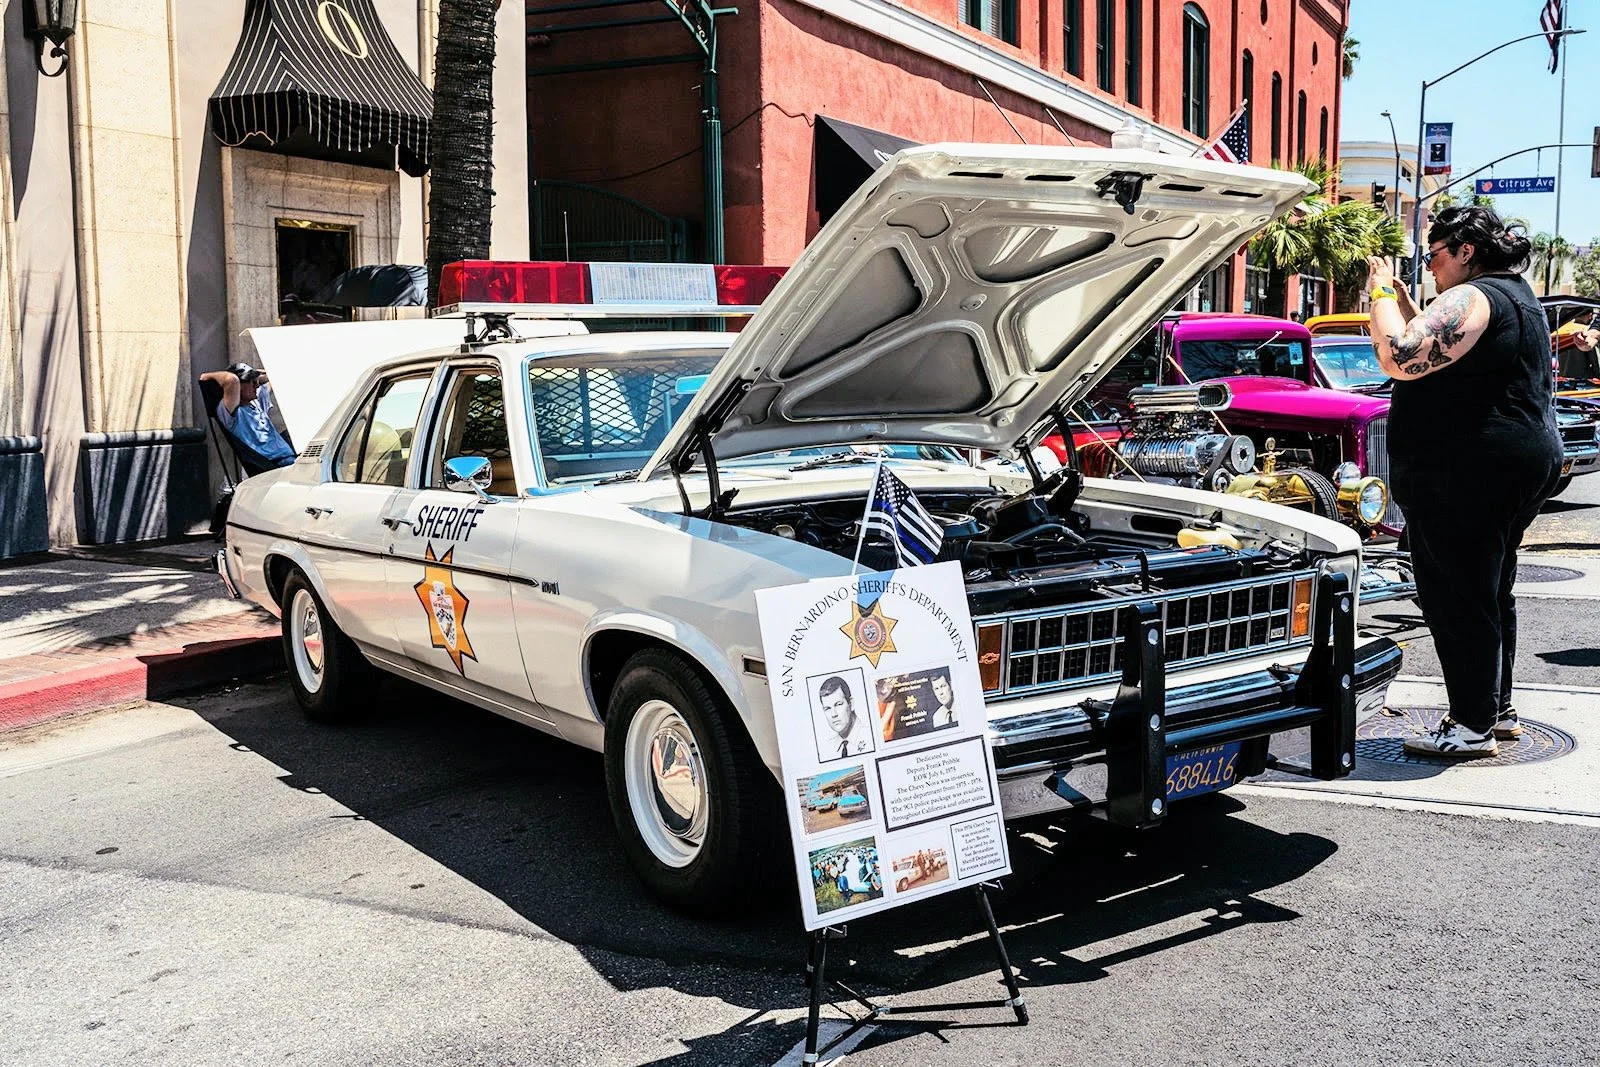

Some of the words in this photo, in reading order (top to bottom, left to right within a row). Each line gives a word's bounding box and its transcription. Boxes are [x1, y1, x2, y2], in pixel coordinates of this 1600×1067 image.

[1498, 179, 1531, 188] Citrus
[1536, 178, 1554, 187] Ave
[412, 504, 484, 542] SHERIFF
[851, 580, 907, 596] SHERIFF'S
[785, 586, 849, 661] BERNARDINO
[908, 587, 969, 662] DEPARTMENT
[782, 665, 794, 697] SAN
[917, 753, 942, 764] Dedicated
[927, 762, 941, 770] Frank
[929, 771, 939, 779] July
[909, 783, 924, 793] Chevy
[913, 787, 942, 800] department
[914, 799, 929, 809] police
[931, 794, 951, 805] package
[964, 786, 984, 795] available
[892, 810, 921, 823] throughout
[922, 803, 946, 814] California
